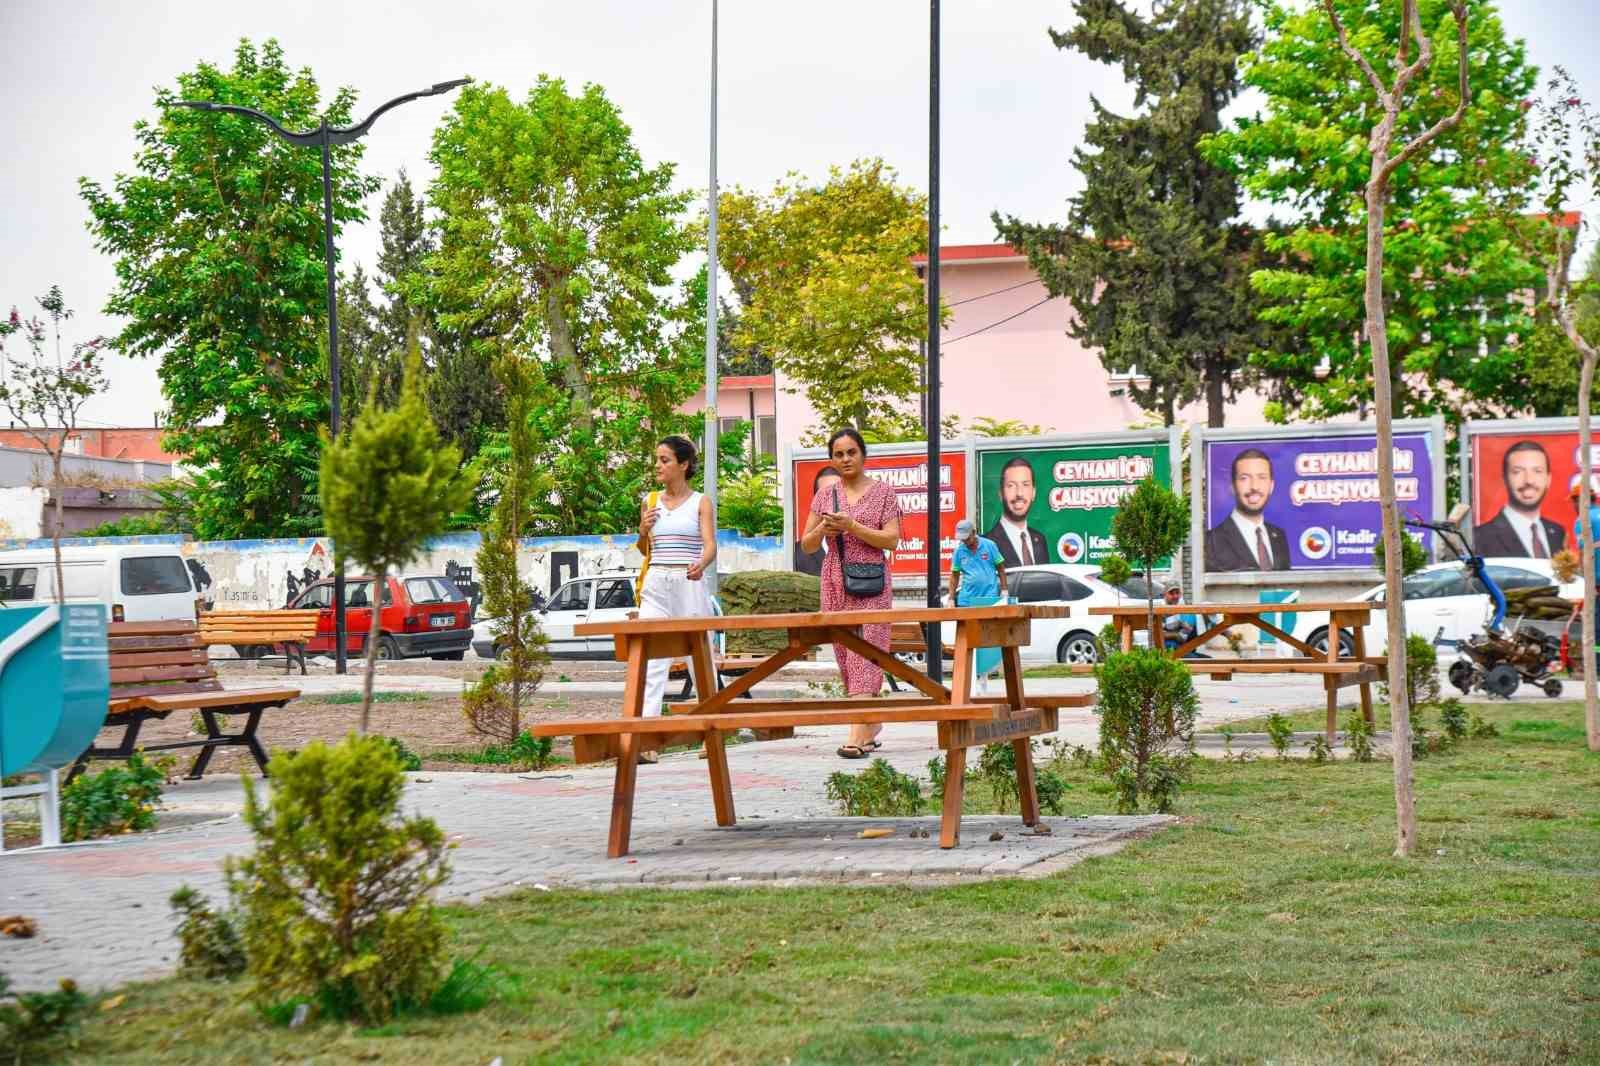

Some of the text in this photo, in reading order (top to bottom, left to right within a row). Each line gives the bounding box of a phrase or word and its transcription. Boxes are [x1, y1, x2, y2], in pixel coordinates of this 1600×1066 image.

[1055, 460, 1118, 481] CEYHAN
[1297, 449, 1412, 474] CEYHAN İİN
[864, 469, 918, 487] EYHAN
[1050, 486, 1136, 511] ÇALIŞIYO
[1292, 478, 1416, 504] ÇALIŞIYORZ!
[1089, 535, 1118, 548] Kad
[1337, 529, 1376, 544] Kadir
